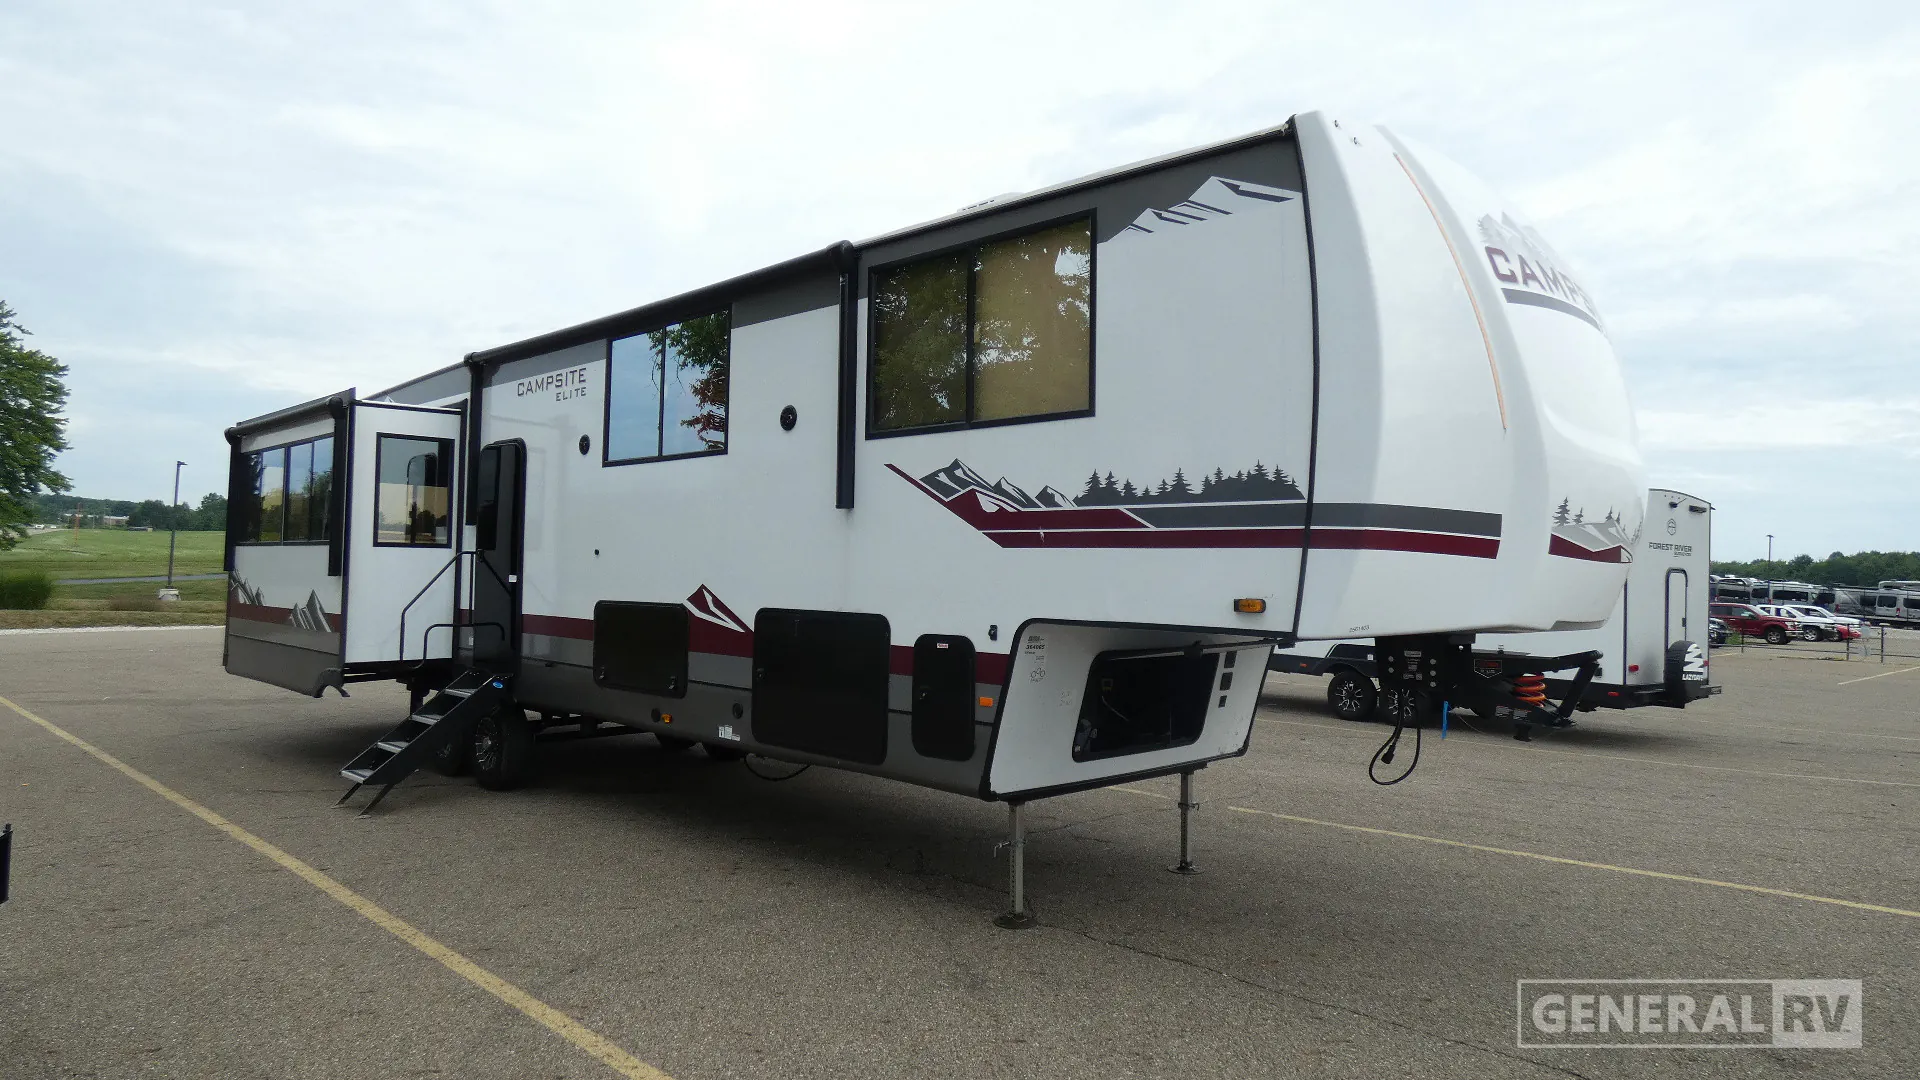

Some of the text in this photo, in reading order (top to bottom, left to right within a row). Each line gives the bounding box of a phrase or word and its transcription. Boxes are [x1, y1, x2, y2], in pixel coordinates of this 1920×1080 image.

[517, 367, 587, 397] CAMPSITE
[555, 387, 587, 402] ELITE
[1649, 542, 1673, 551] FOREST
